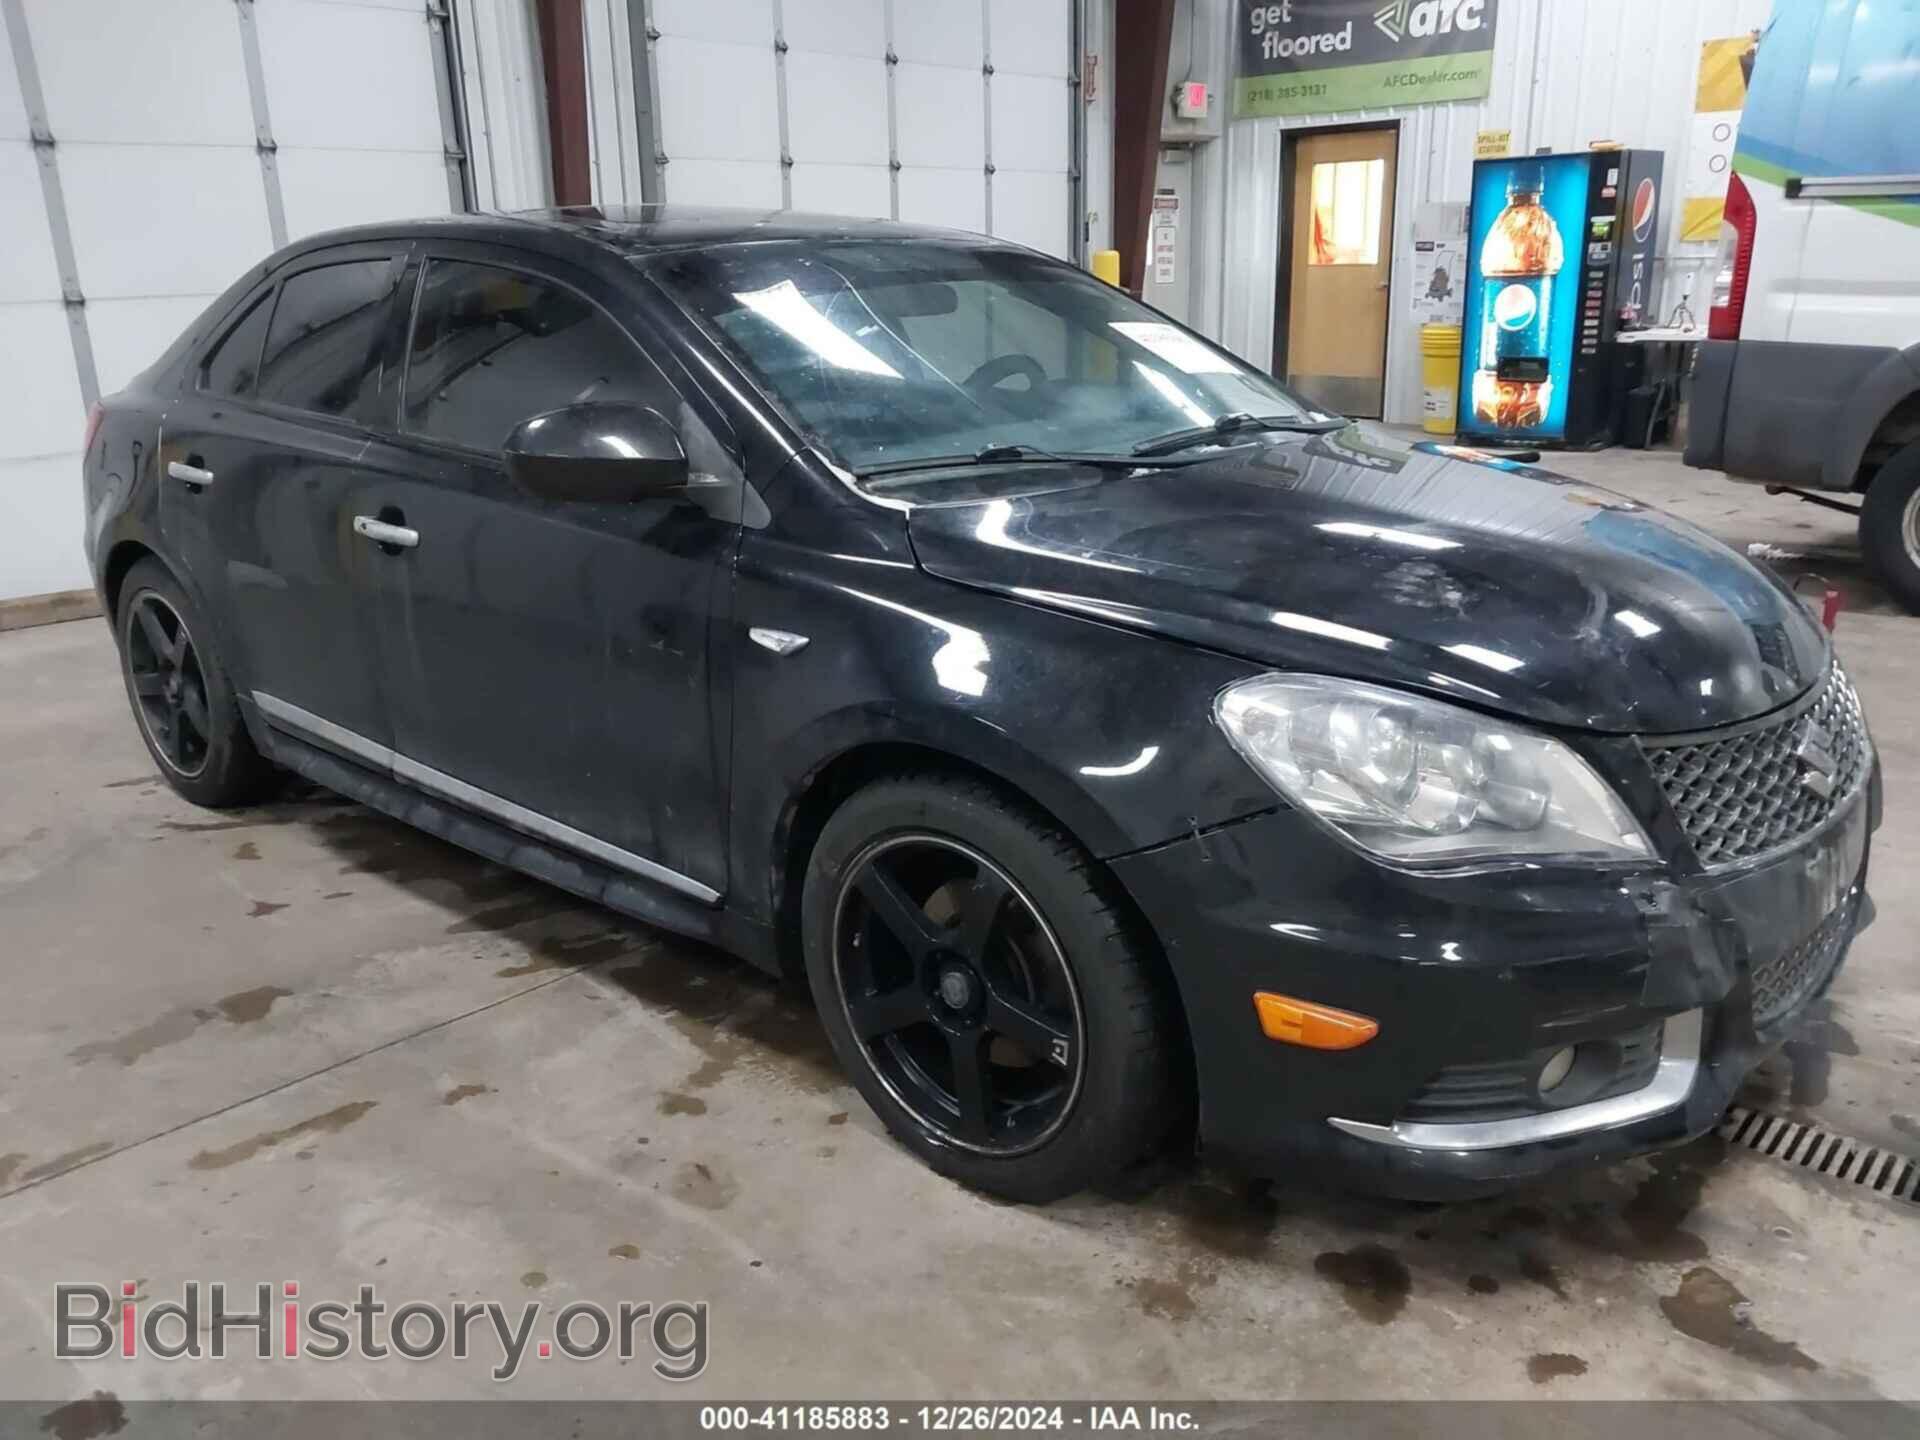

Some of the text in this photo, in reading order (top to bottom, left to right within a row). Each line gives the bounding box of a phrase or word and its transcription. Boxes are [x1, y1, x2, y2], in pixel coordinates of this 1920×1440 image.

[1250, 0, 1292, 34] get
[1408, 0, 1485, 37] afc
[1262, 20, 1352, 59] floored
[1382, 69, 1480, 88] AFCDealer.com
